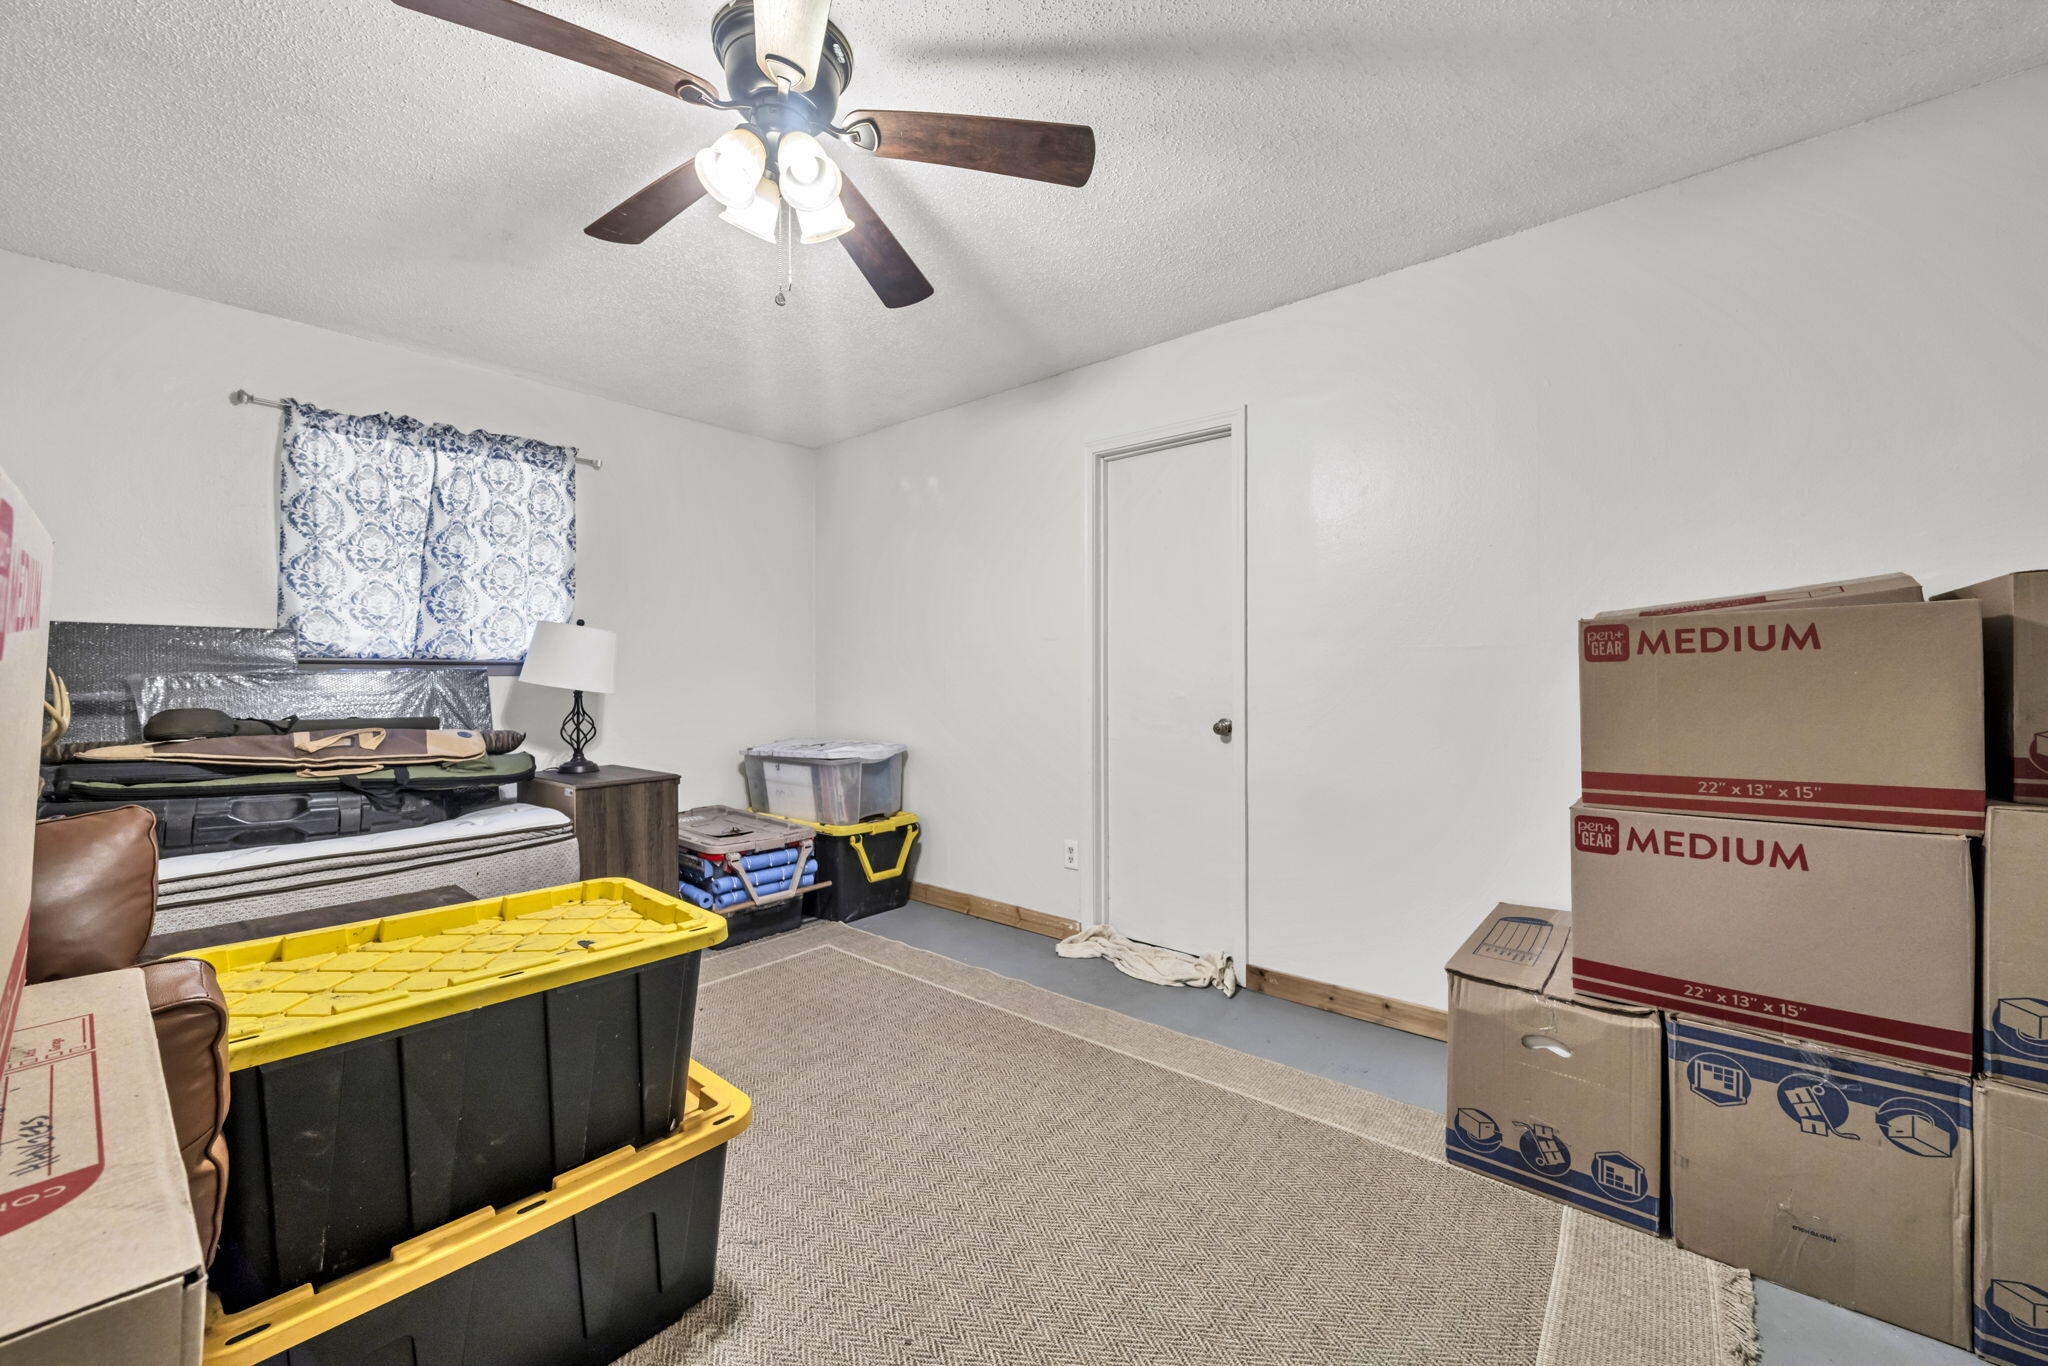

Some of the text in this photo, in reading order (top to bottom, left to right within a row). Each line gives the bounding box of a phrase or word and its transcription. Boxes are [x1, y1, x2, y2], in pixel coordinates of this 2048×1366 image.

[1637, 622, 1821, 655] MEDIUM
[1591, 641, 1622, 656] GEAR
[1731, 786, 1741, 795] x
[1778, 788, 1789, 798] x
[1582, 831, 1612, 848] GEAR
[1626, 826, 1809, 871] MEDIUM
[1717, 993, 1727, 1003] x
[1763, 1003, 1774, 1013] x
